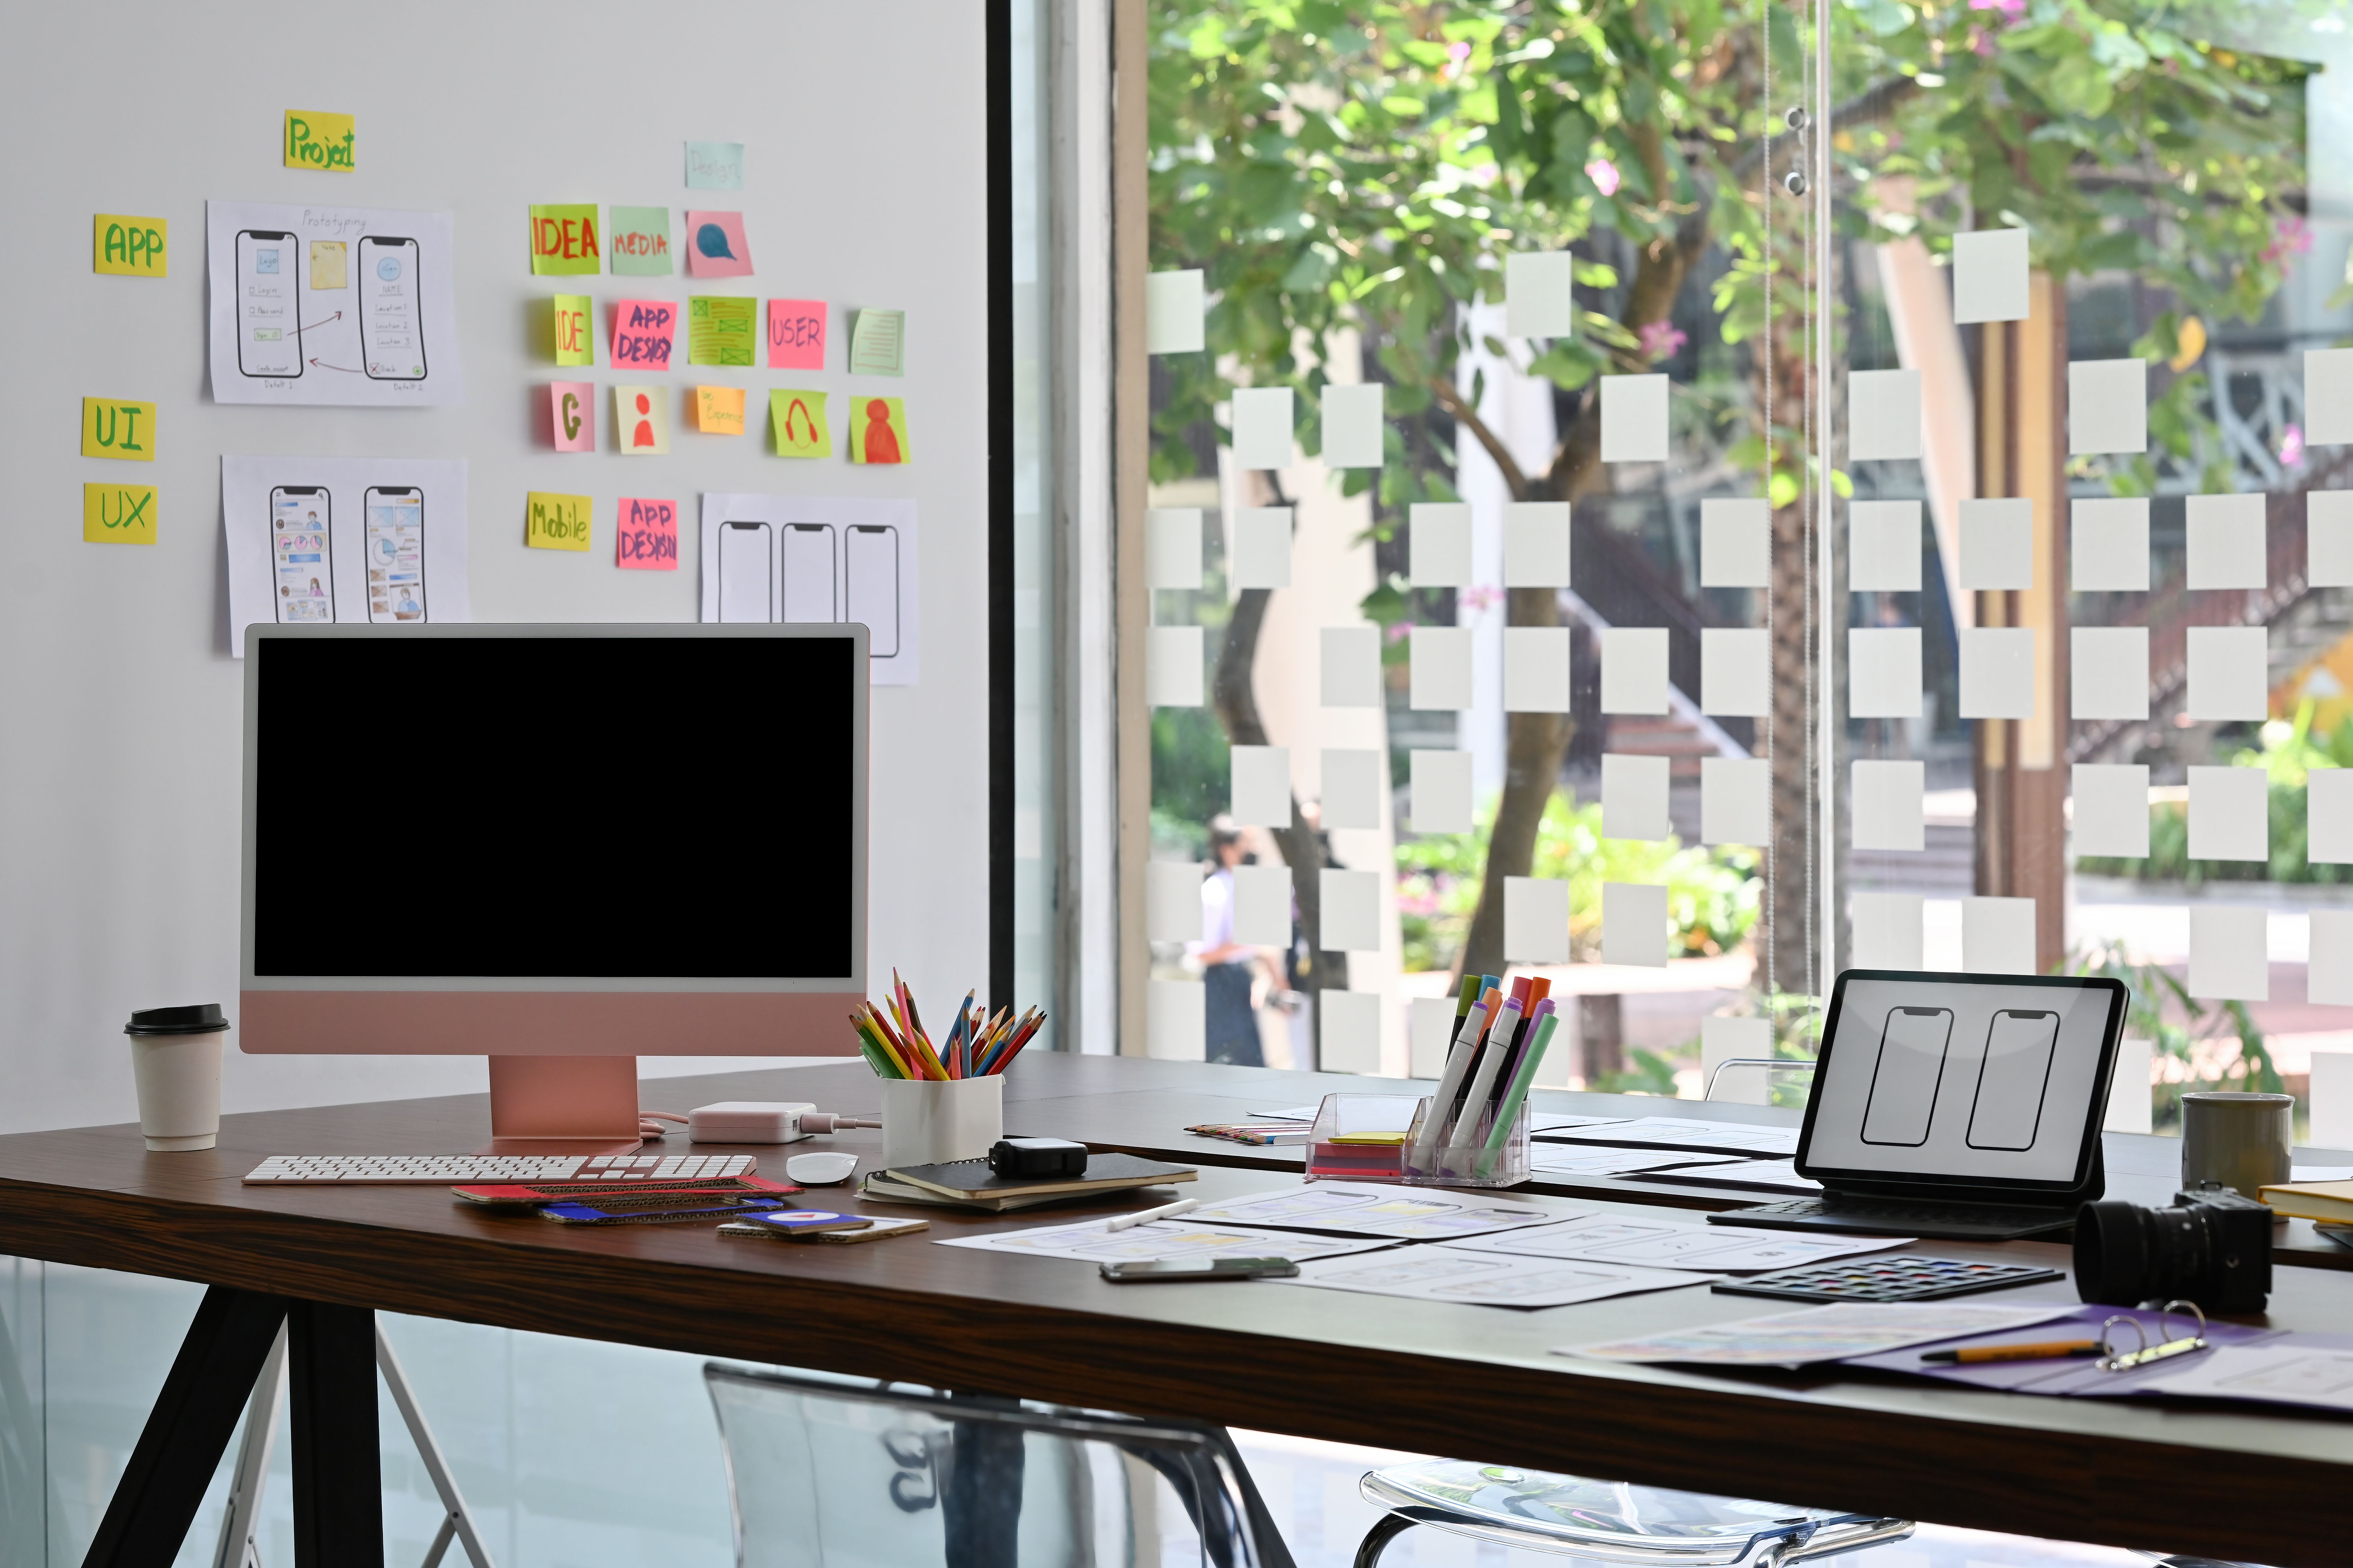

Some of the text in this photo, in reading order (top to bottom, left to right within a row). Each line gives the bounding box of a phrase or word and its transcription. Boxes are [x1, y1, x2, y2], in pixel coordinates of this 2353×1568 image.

[290, 115, 355, 169] Project
[302, 209, 366, 236] Prototyping
[533, 216, 599, 259] IDEA
[105, 223, 163, 269] APP
[614, 232, 667, 256] MEDIA
[629, 304, 670, 329] APP
[772, 315, 821, 347] USER
[96, 404, 143, 451] UI
[102, 490, 151, 528] UX
[533, 502, 587, 542] Mobile
